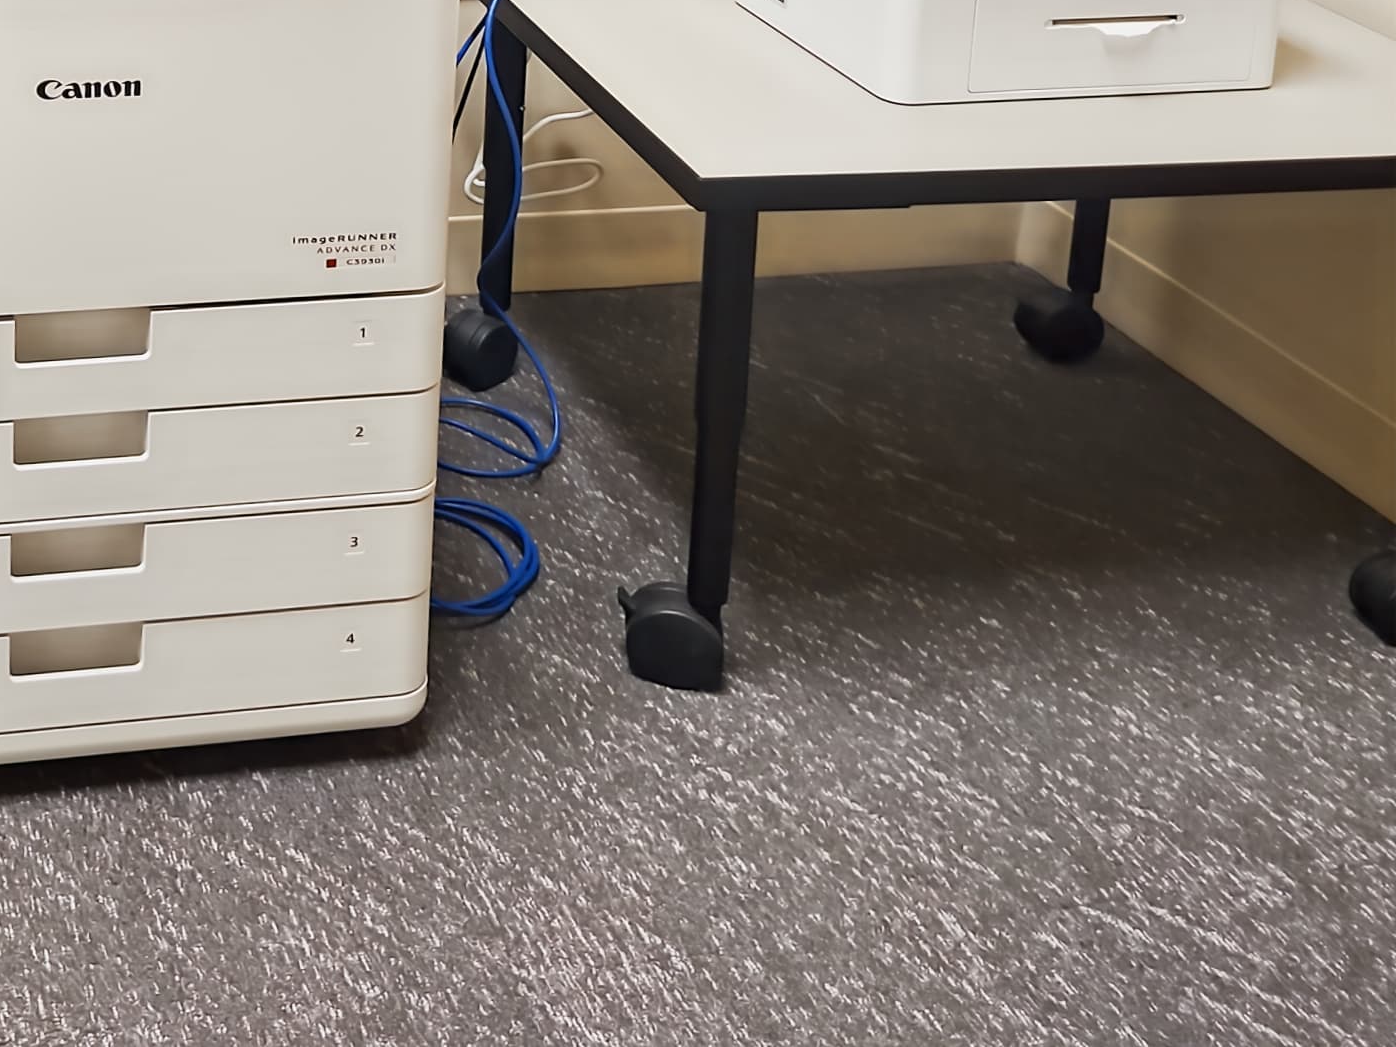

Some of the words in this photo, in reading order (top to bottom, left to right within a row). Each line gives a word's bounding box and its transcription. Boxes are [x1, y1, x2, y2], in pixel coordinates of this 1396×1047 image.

[36, 79, 141, 100] Canon
[292, 233, 397, 244] imageRUNNER
[317, 244, 375, 254] ADVANCE
[380, 243, 396, 251] DX
[355, 426, 364, 438] 2
[350, 536, 359, 548] 3
[346, 633, 355, 645] 4
